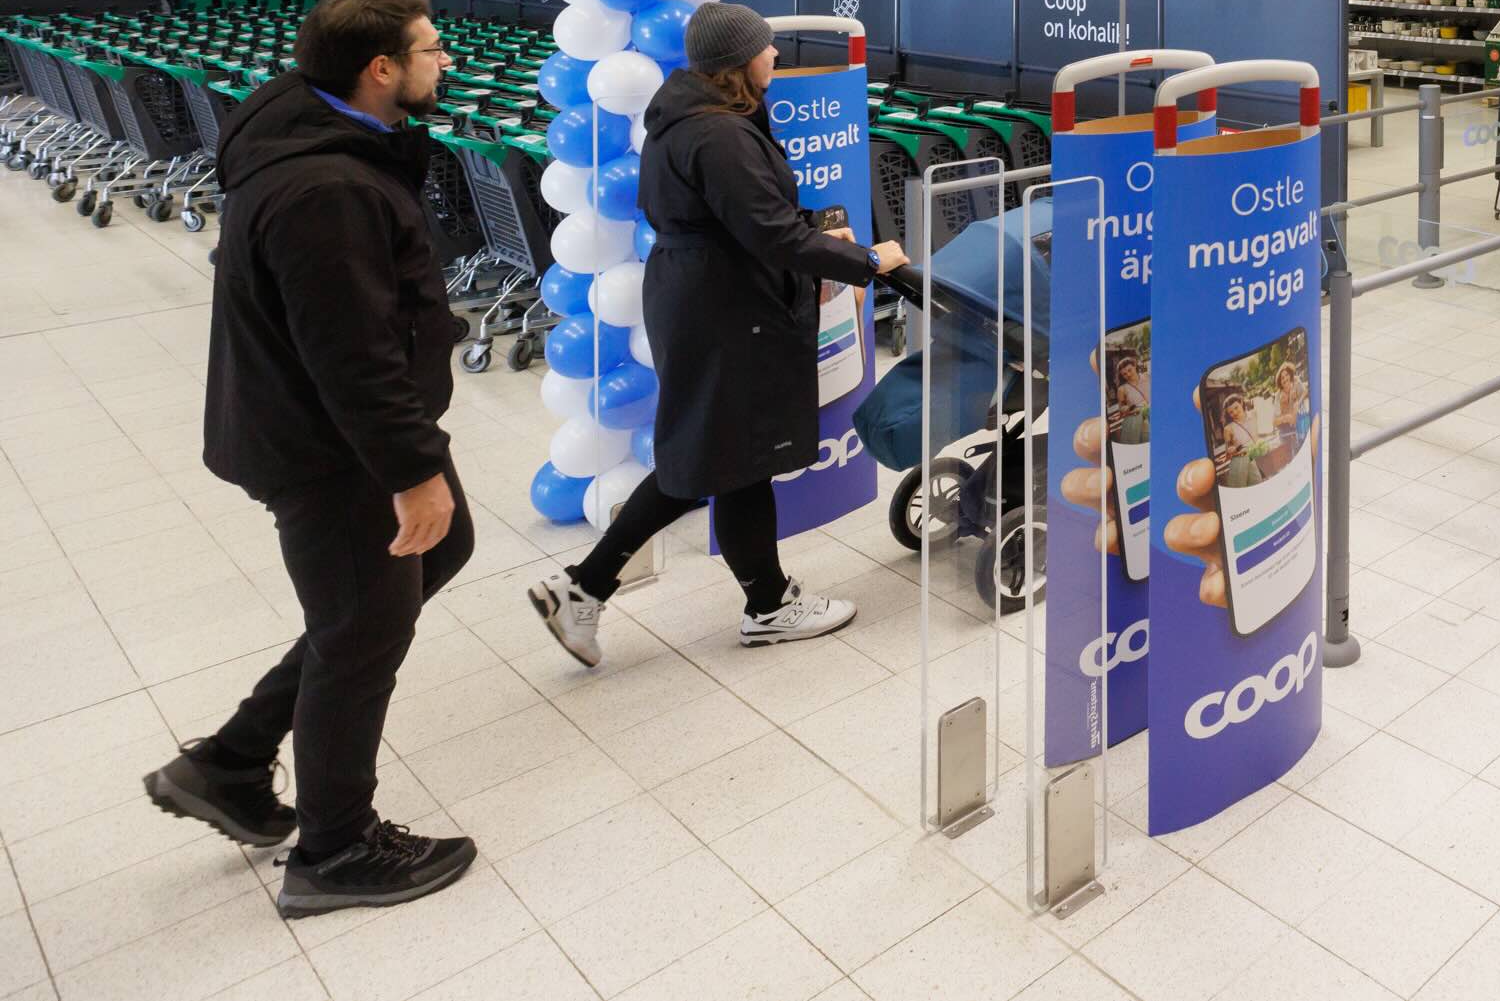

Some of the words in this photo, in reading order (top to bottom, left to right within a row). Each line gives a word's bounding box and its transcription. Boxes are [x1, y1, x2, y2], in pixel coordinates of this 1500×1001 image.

[1044, 22, 1064, 38] on
[770, 97, 841, 124] Ostle
[1231, 175, 1305, 216] Ostle
[1188, 210, 1318, 269] mugavalt
[1225, 267, 1305, 316] äpiga
[1184, 631, 1318, 740] coop
